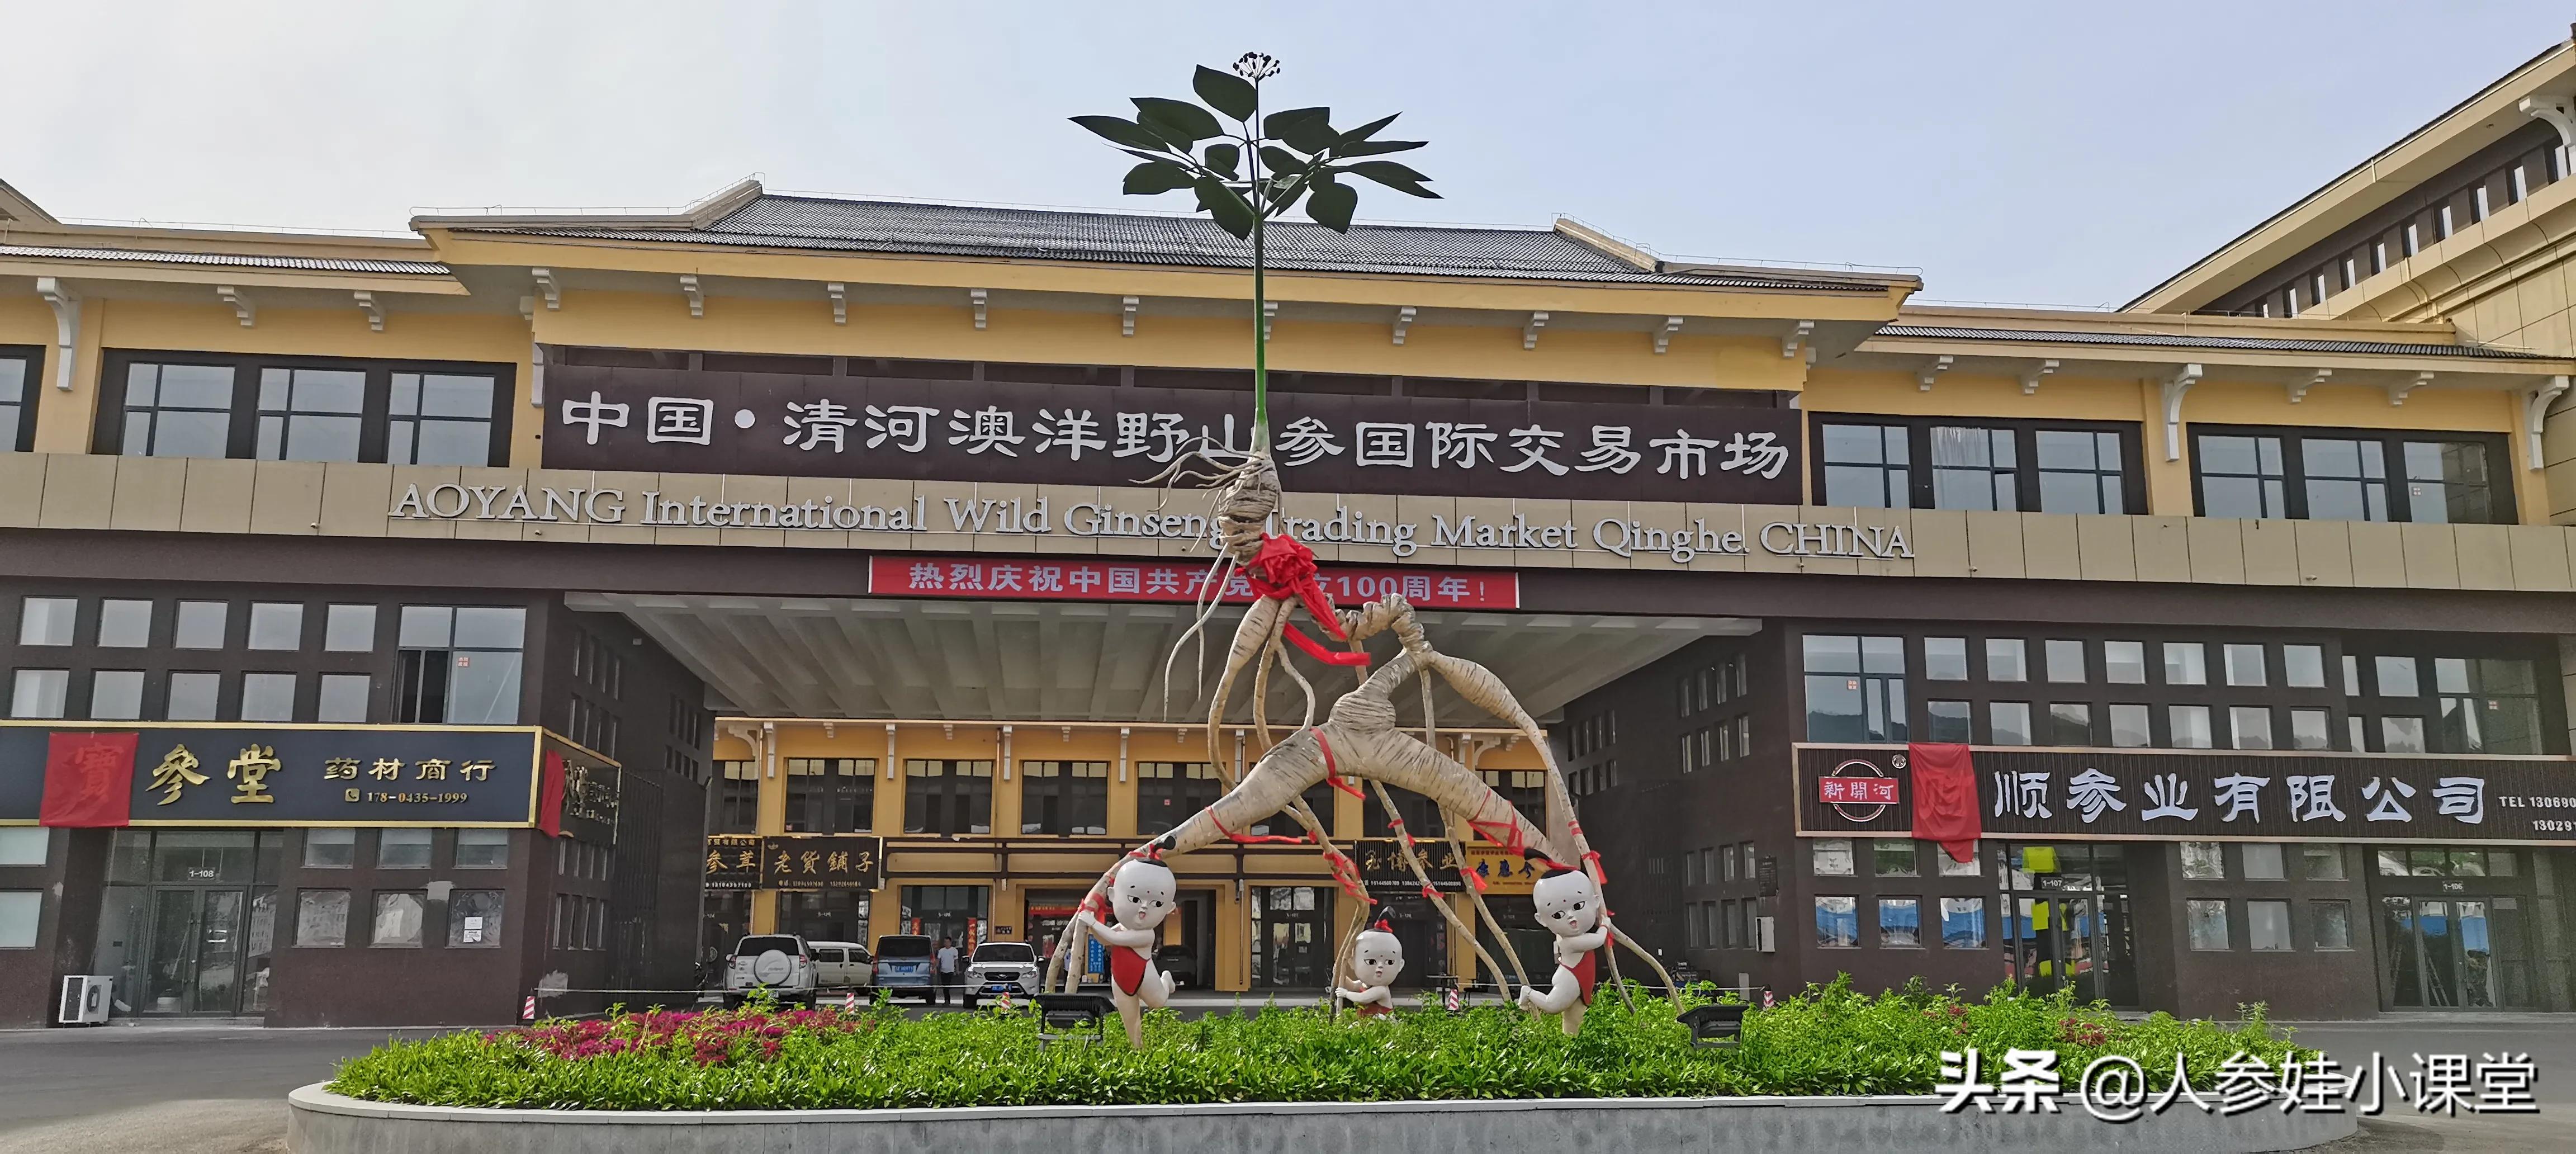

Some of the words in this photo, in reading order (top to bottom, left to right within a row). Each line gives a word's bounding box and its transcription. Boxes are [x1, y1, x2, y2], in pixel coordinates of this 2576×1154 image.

[388, 483, 626, 523] AOYANG
[640, 490, 928, 532] International
[944, 495, 1052, 533] Wild
[1431, 513, 1579, 548] Market
[1760, 521, 1916, 559] CHINA
[909, 562, 1485, 602] 热烈庆祝中国共产党100周年！
[324, 756, 496, 782] 药材商行
[367, 792, 468, 803] 178-0435-1999
[1994, 768, 2485, 824] 顺参业有限公司
[2498, 796, 2525, 807] TEL
